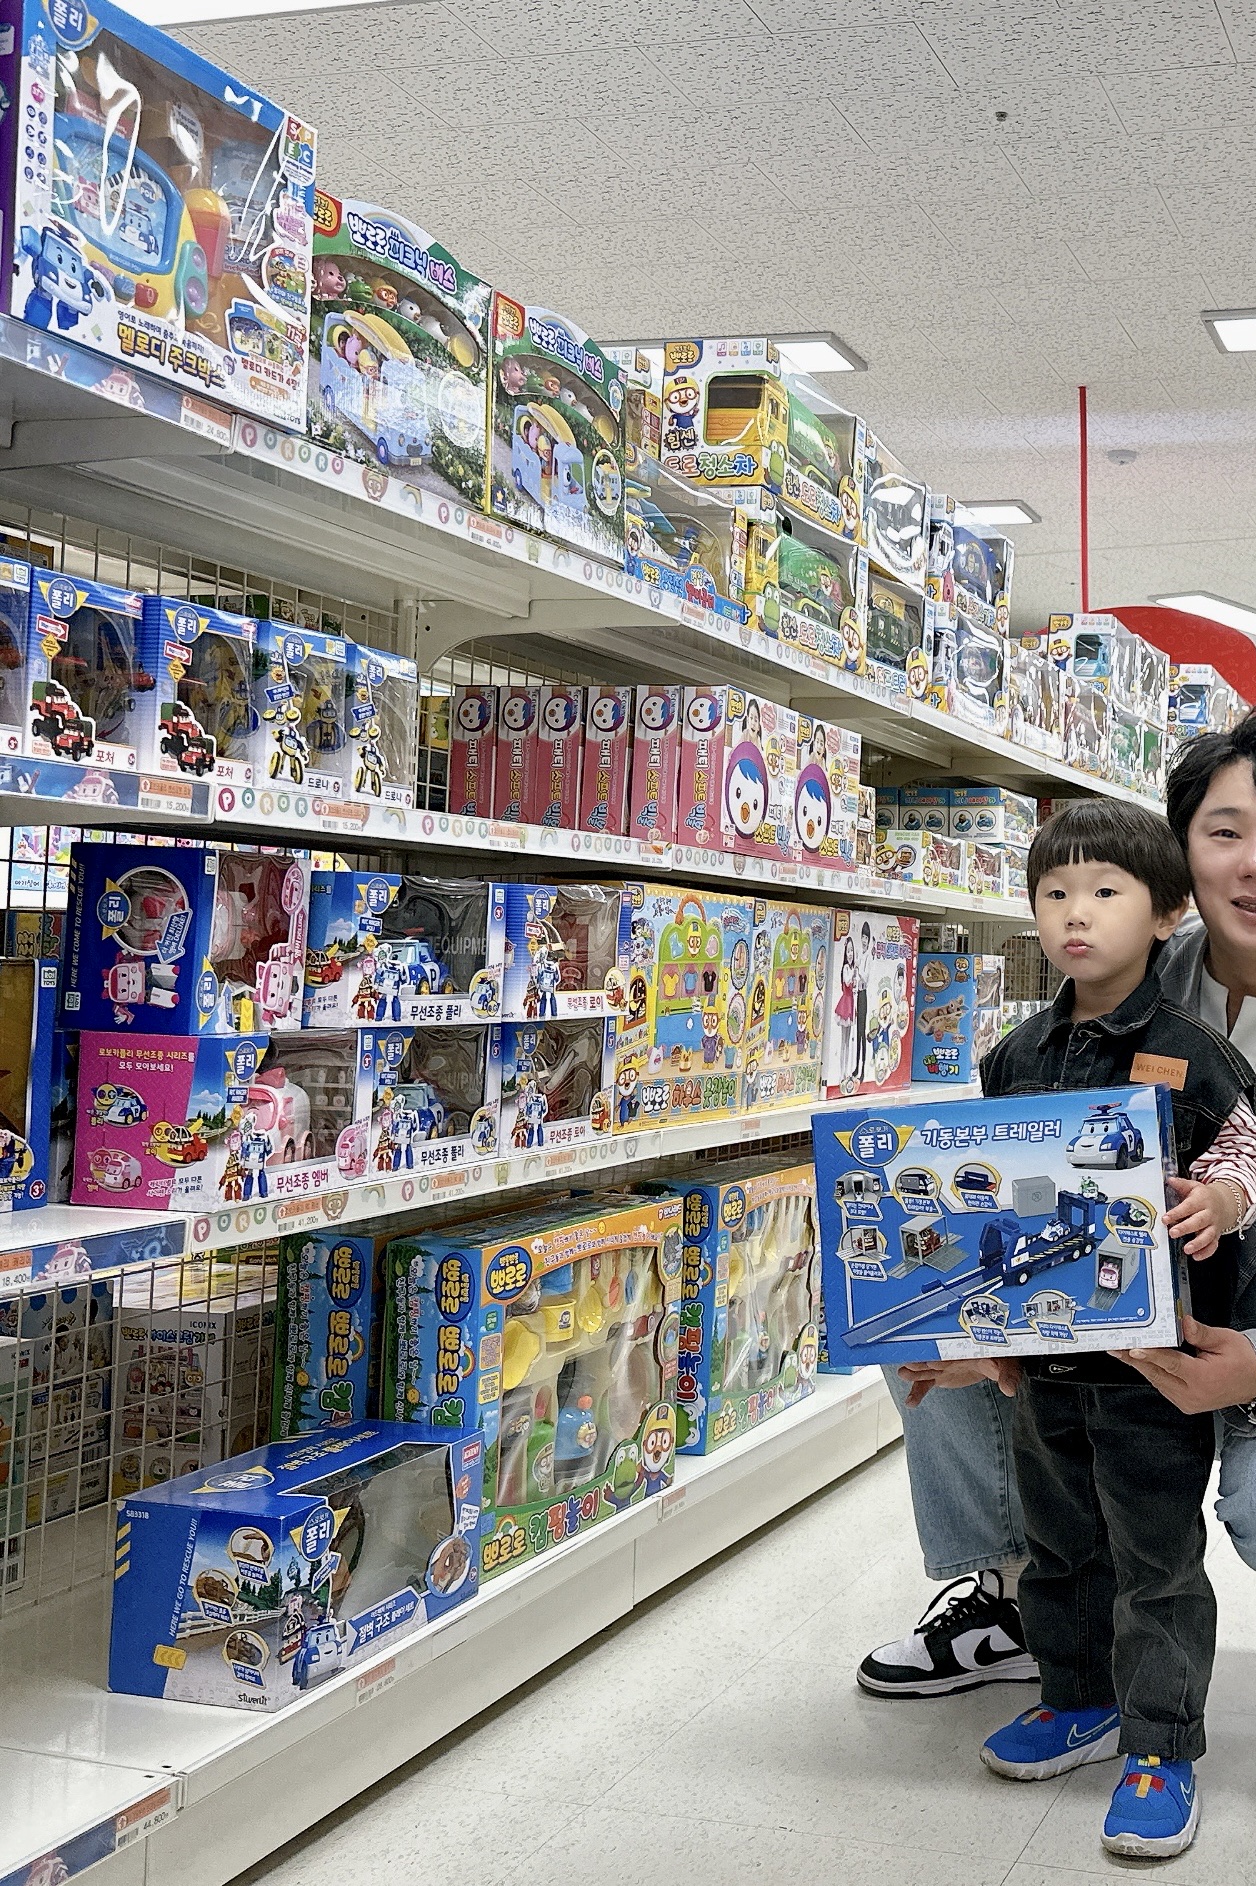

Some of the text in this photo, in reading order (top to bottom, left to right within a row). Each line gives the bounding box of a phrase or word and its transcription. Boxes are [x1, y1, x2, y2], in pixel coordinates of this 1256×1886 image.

[347, 212, 387, 255] 뽀로로
[429, 260, 456, 292] 버스
[528, 316, 556, 352] 뽀로로
[117, 322, 226, 389] 멜로디 주크박스
[666, 429, 697, 451] 힘센
[664, 453, 758, 478] 도로청소차
[51, 588, 74, 610] 폴리
[176, 616, 197, 636] 폴리
[284, 640, 303, 660] 폴리
[368, 663, 384, 682] 폴리
[96, 750, 115, 765] 포처
[216, 765, 234, 779] 포처
[308, 777, 329, 790] 드로니
[385, 790, 402, 802] 드로니
[108, 896, 124, 922] 폴리
[368, 889, 387, 907] 폴리
[535, 899, 550, 915] 폴리
[75, 917, 82, 928] TO
[73, 931, 81, 951] COME
[73, 952, 80, 966] WE
[70, 968, 79, 988] HERE
[410, 1005, 443, 1021] 무선조종
[384, 1040, 402, 1060] 폴리
[523, 1034, 538, 1050] 폴리
[236, 1053, 256, 1075] 폴리
[932, 1047, 960, 1060] 뽀로로
[118, 1061, 134, 1071] 모두
[927, 1063, 960, 1078] 비행기
[1157, 1067, 1183, 1078] CHEN
[641, 1079, 702, 1114] 뽀로로 하우스
[921, 1120, 1062, 1149] 기동본부 트레일러
[420, 1148, 450, 1166] 무선조종
[858, 1134, 894, 1159] 폴리
[276, 1168, 330, 1194] 무선조종 엠버
[686, 1193, 703, 1237] 뽀로로
[332, 1246, 352, 1300] 뽀로로
[490, 1262, 528, 1295] 뽀로로
[442, 1258, 461, 1314] 뽀로로
[677, 1247, 704, 1402] 뽀로로 캠핑놀이
[327, 1311, 350, 1378] 뽀로로
[437, 1326, 461, 1396] 뽀로로
[713, 1413, 738, 1442] 뽀로로
[306, 1525, 330, 1554] 폴리
[483, 1486, 600, 1572] 뽀로로 캠핑놀이
[183, 1545, 194, 1578] RESCUE
[178, 1588, 184, 1600] GO
[180, 1578, 187, 1588] TO
[174, 1599, 182, 1614] WE
[169, 1614, 179, 1637] HERE
[375, 1612, 391, 1634] 구조
